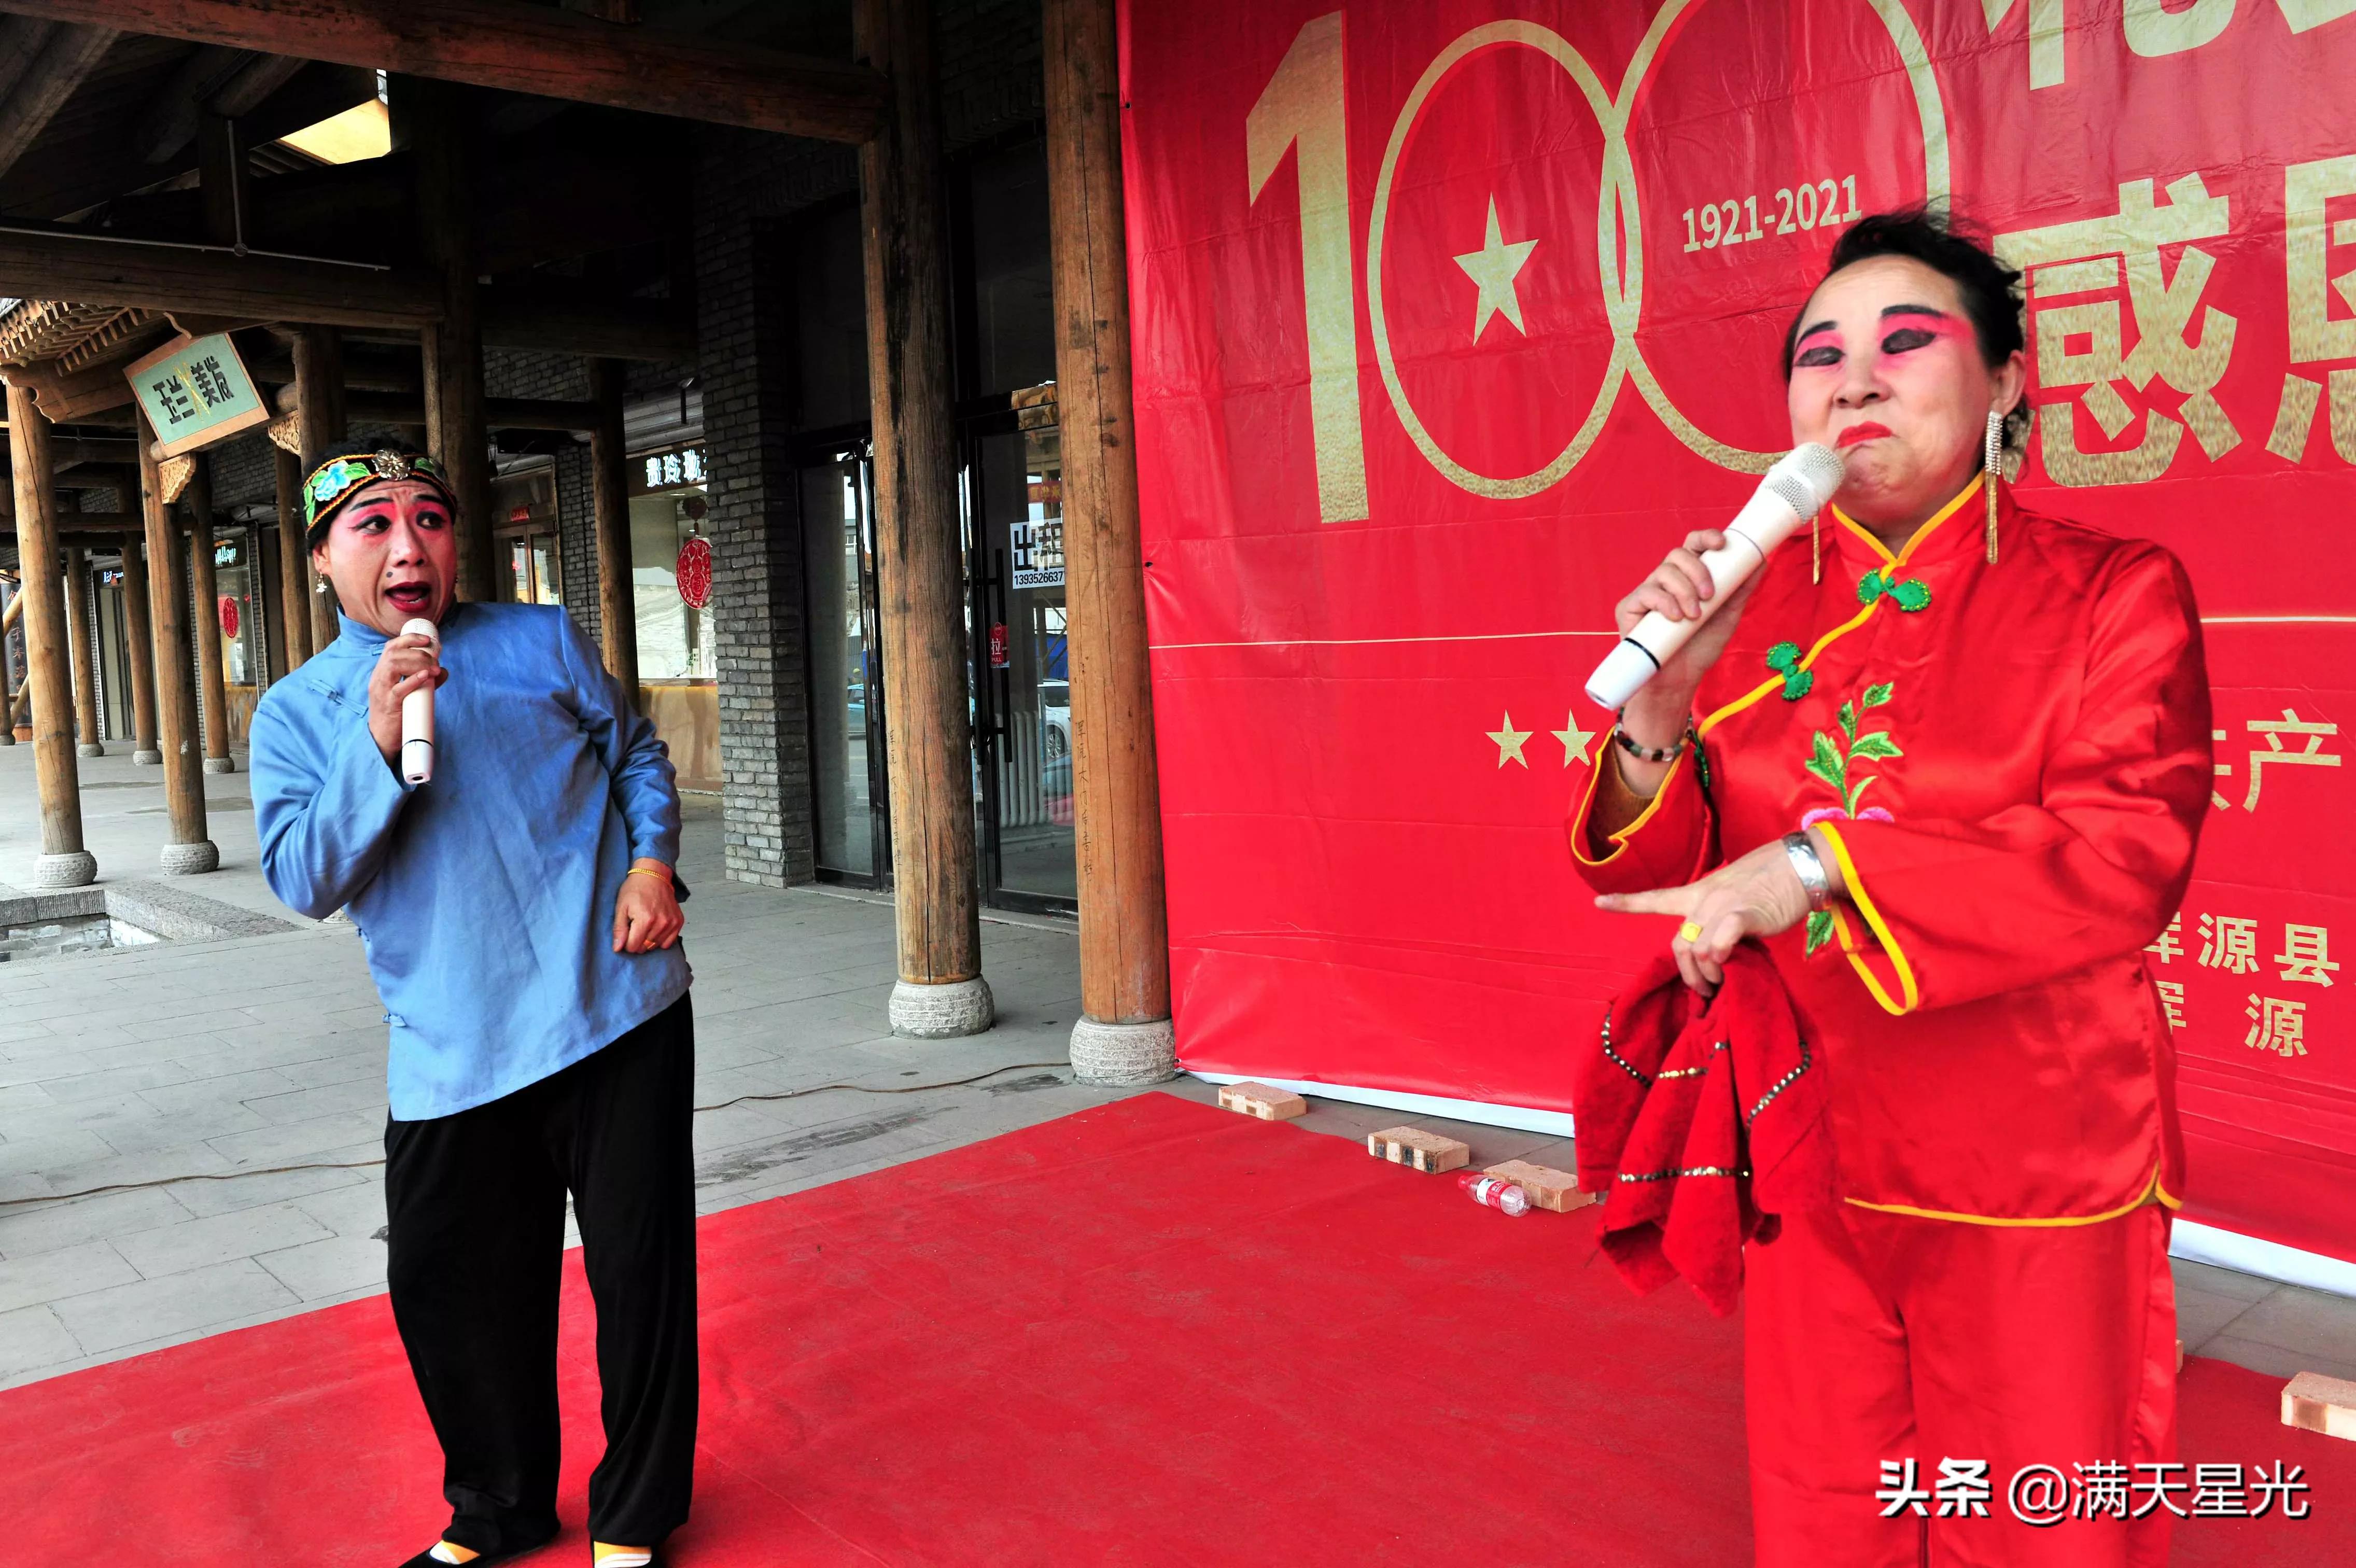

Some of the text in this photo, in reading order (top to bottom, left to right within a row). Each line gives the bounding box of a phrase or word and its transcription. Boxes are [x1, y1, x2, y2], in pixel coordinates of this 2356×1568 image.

[1682, 174, 1862, 253] 1921-2021
[1245, 0, 1951, 524] 100
[646, 449, 707, 487] 贵玲珑
[1014, 522, 1064, 571] 出租
[1014, 570, 1065, 585] 1393526637
[991, 638, 1001, 655] 拉
